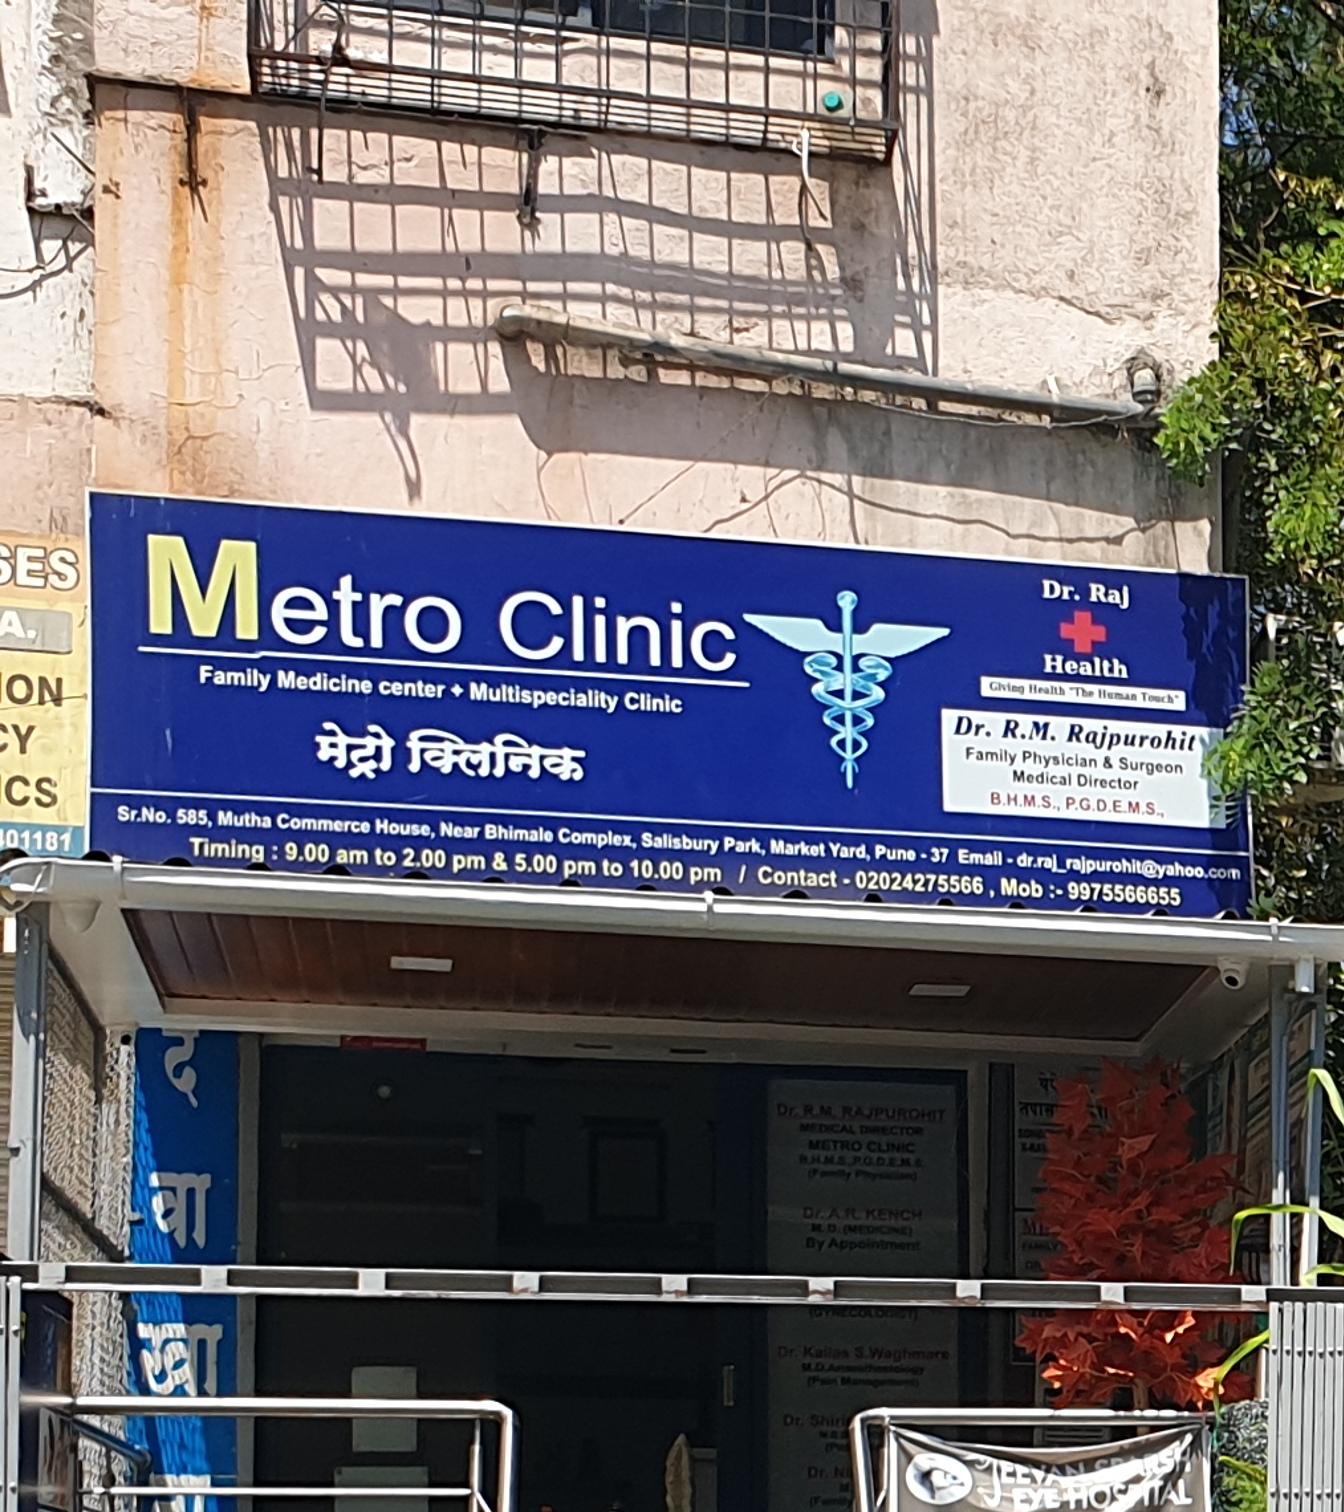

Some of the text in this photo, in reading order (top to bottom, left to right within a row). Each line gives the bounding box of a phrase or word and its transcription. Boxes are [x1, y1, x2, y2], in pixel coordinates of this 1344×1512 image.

[147, 534, 736, 674] Metro Clinic
[1043, 580, 1129, 609] Dr. Raj
[200, 666, 682, 713] Family Medicine center Multispeciality Clinic
[1044, 654, 1128, 678] Health
[315, 722, 585, 780] मेट्रो क्लिनिक
[954, 716, 1196, 751] Dr. R.M. Rajpurohit
[966, 747, 1183, 775] Family Physician Surgeon
[118, 806, 171, 823] Sr.No.
[177, 809, 212, 827] 585,
[218, 811, 271, 828] Mutha
[277, 814, 370, 833] Commerce
[376, 819, 435, 838] House,
[440, 822, 480, 838] Near
[485, 824, 553, 842] Bhimale
[558, 828, 636, 848] Complex,
[642, 832, 719, 855] Salisbury
[724, 837, 765, 855] Park,
[770, 839, 825, 857] Market
[829, 842, 870, 861] Yard,
[875, 845, 916, 861] Pune
[931, 848, 948, 862] 37
[958, 849, 1002, 865] Email
[189, 837, 1180, 905] Timing 9.00 2.00 5.00 10.00 Contact 02024275566 Mob 9975566655
